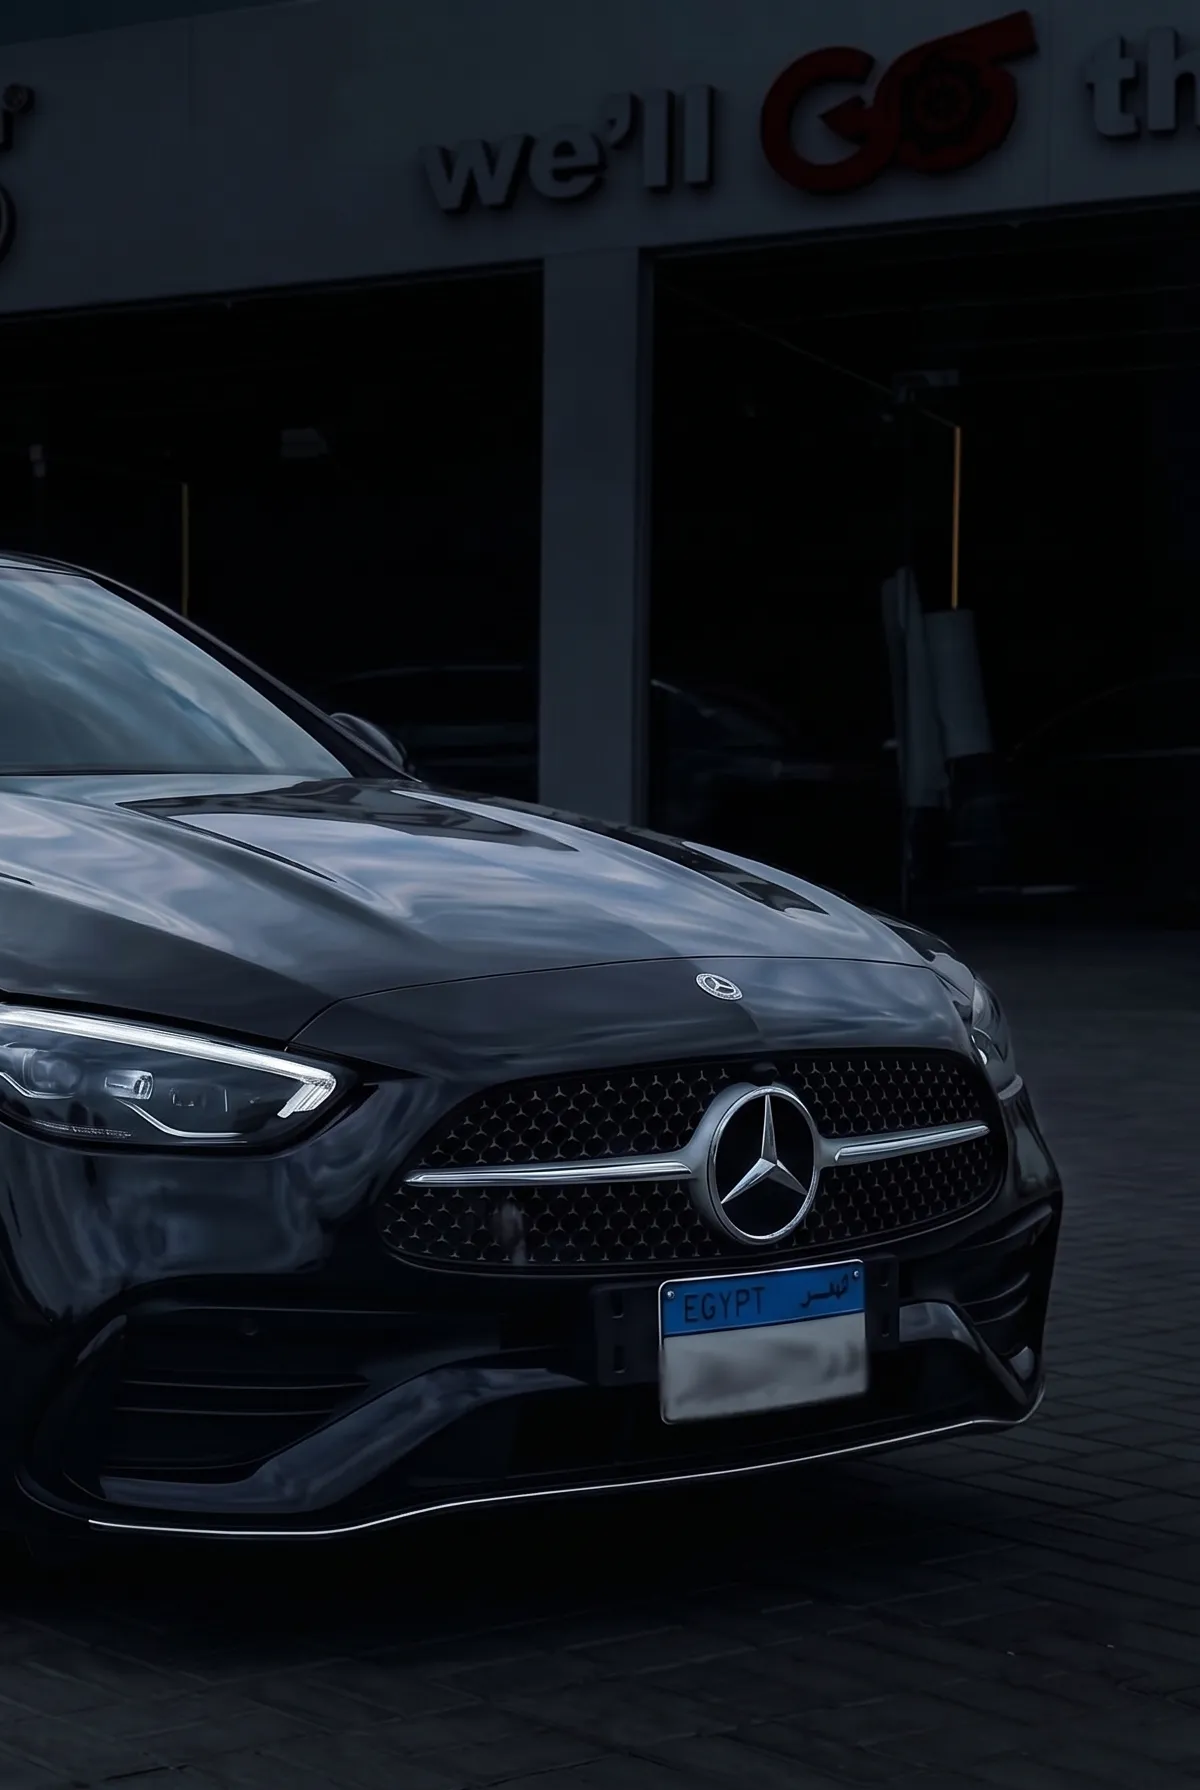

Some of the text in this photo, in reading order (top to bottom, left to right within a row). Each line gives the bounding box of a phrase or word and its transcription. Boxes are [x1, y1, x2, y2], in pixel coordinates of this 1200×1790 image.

[420, 84, 717, 213] we'll
[684, 1286, 766, 1323] EGYPT
[800, 1273, 849, 1308] مصر
